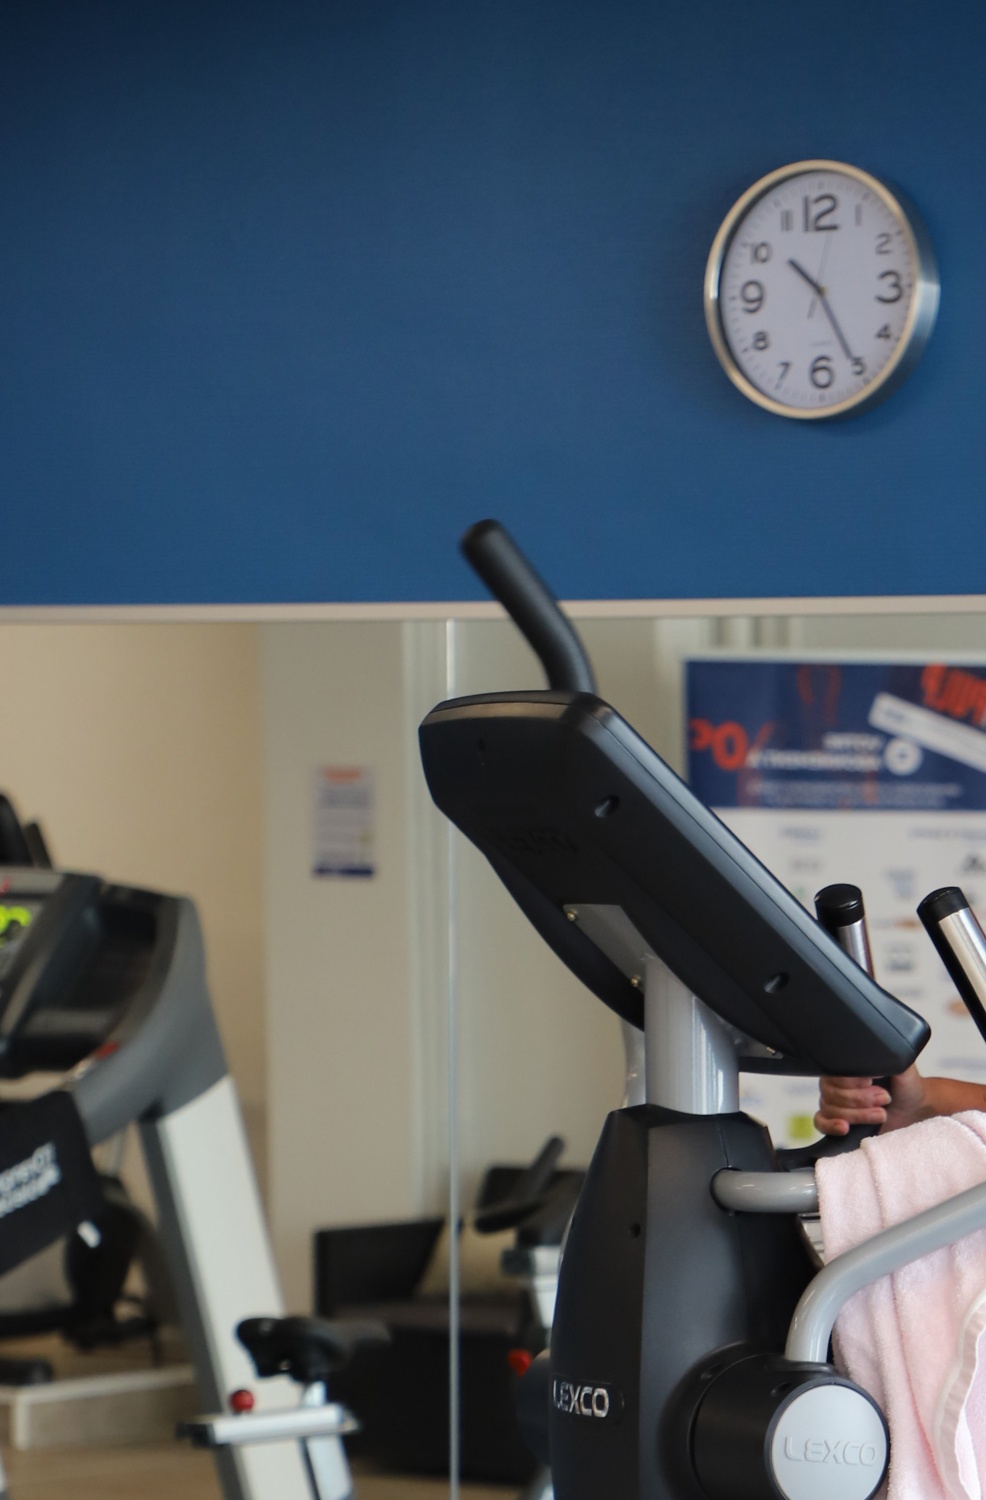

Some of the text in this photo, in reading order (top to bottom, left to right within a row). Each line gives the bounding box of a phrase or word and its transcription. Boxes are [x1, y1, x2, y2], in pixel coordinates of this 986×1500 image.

[803, 194, 839, 232] 12
[855, 203, 863, 226] 1
[875, 233, 892, 255] 2
[741, 280, 764, 314] 9
[875, 269, 903, 304] 3
[753, 331, 769, 351] 8
[875, 324, 891, 341] 4
[774, 361, 792, 391] 7
[810, 355, 834, 390] 6
[552, 1379, 610, 1418] LEXCO
[783, 1436, 876, 1466] LEXCO
